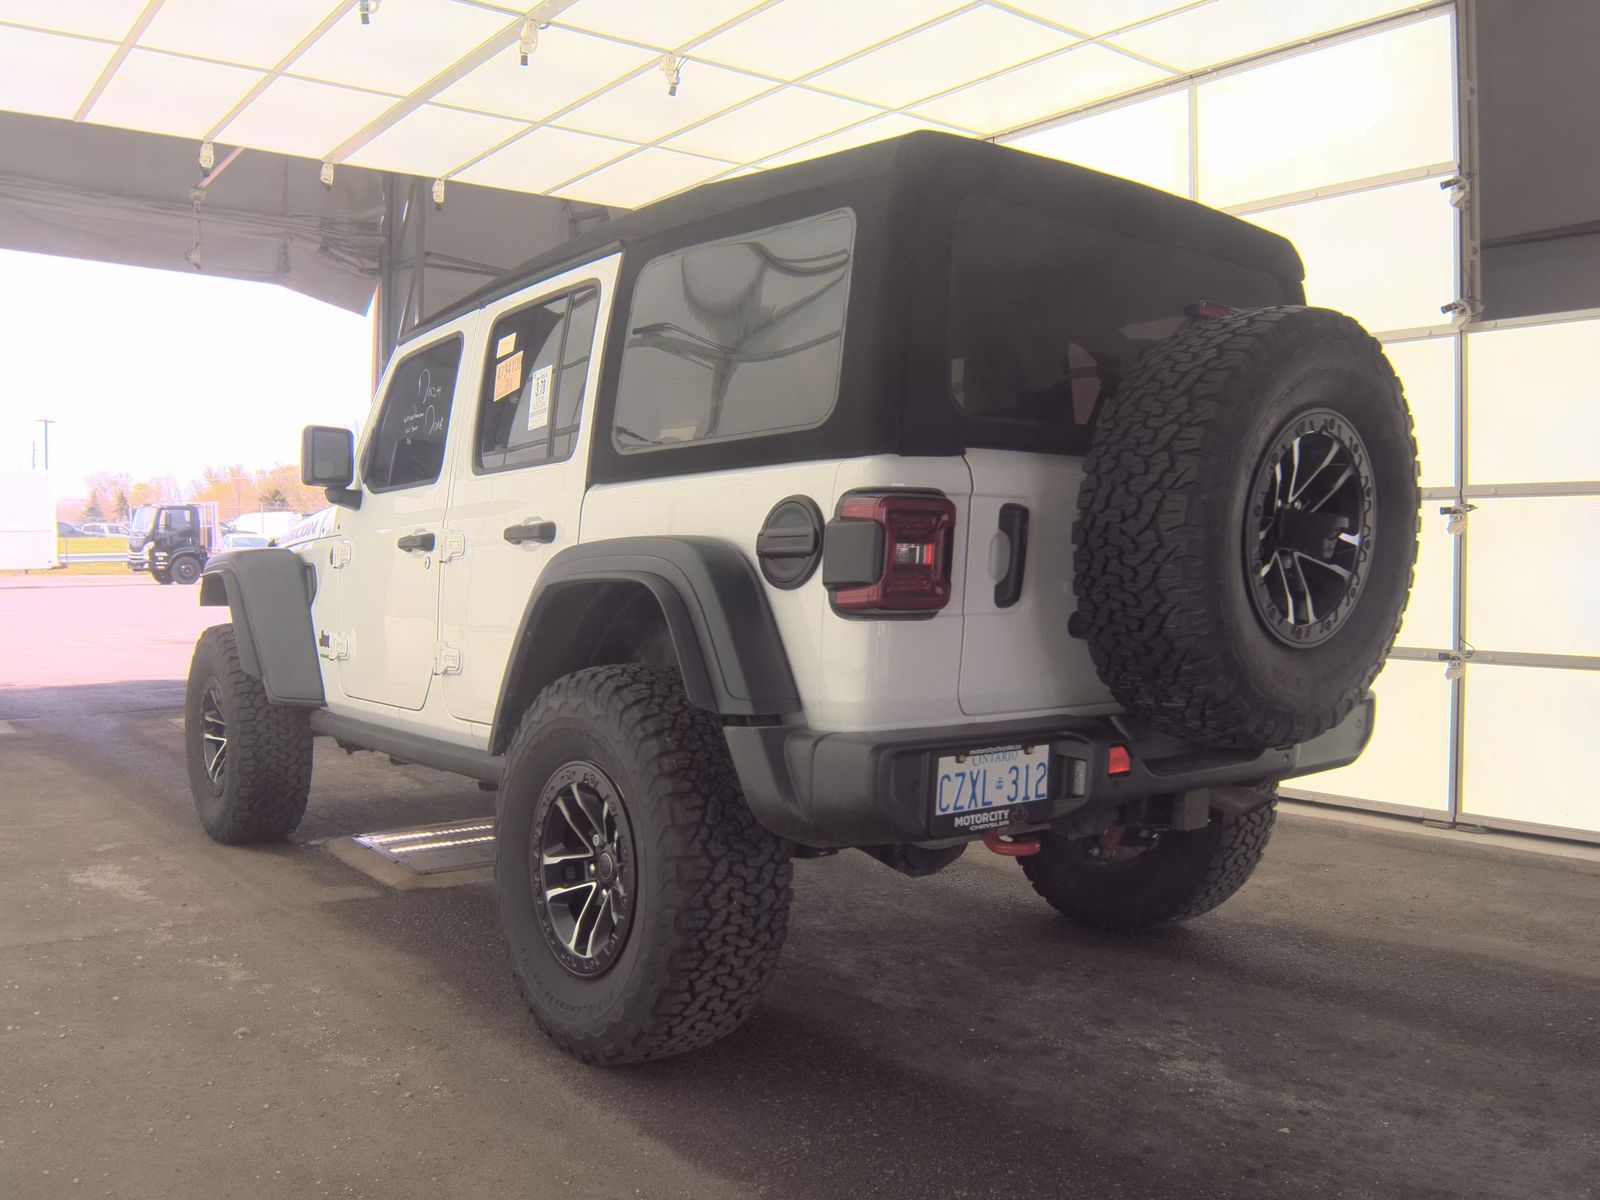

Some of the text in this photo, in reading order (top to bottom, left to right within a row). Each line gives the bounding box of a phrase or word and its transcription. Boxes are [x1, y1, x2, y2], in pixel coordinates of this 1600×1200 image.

[971, 750, 1018, 767] ONTARIO
[938, 761, 1047, 813] CZXL 312
[954, 809, 1010, 828] MOTORCITY
